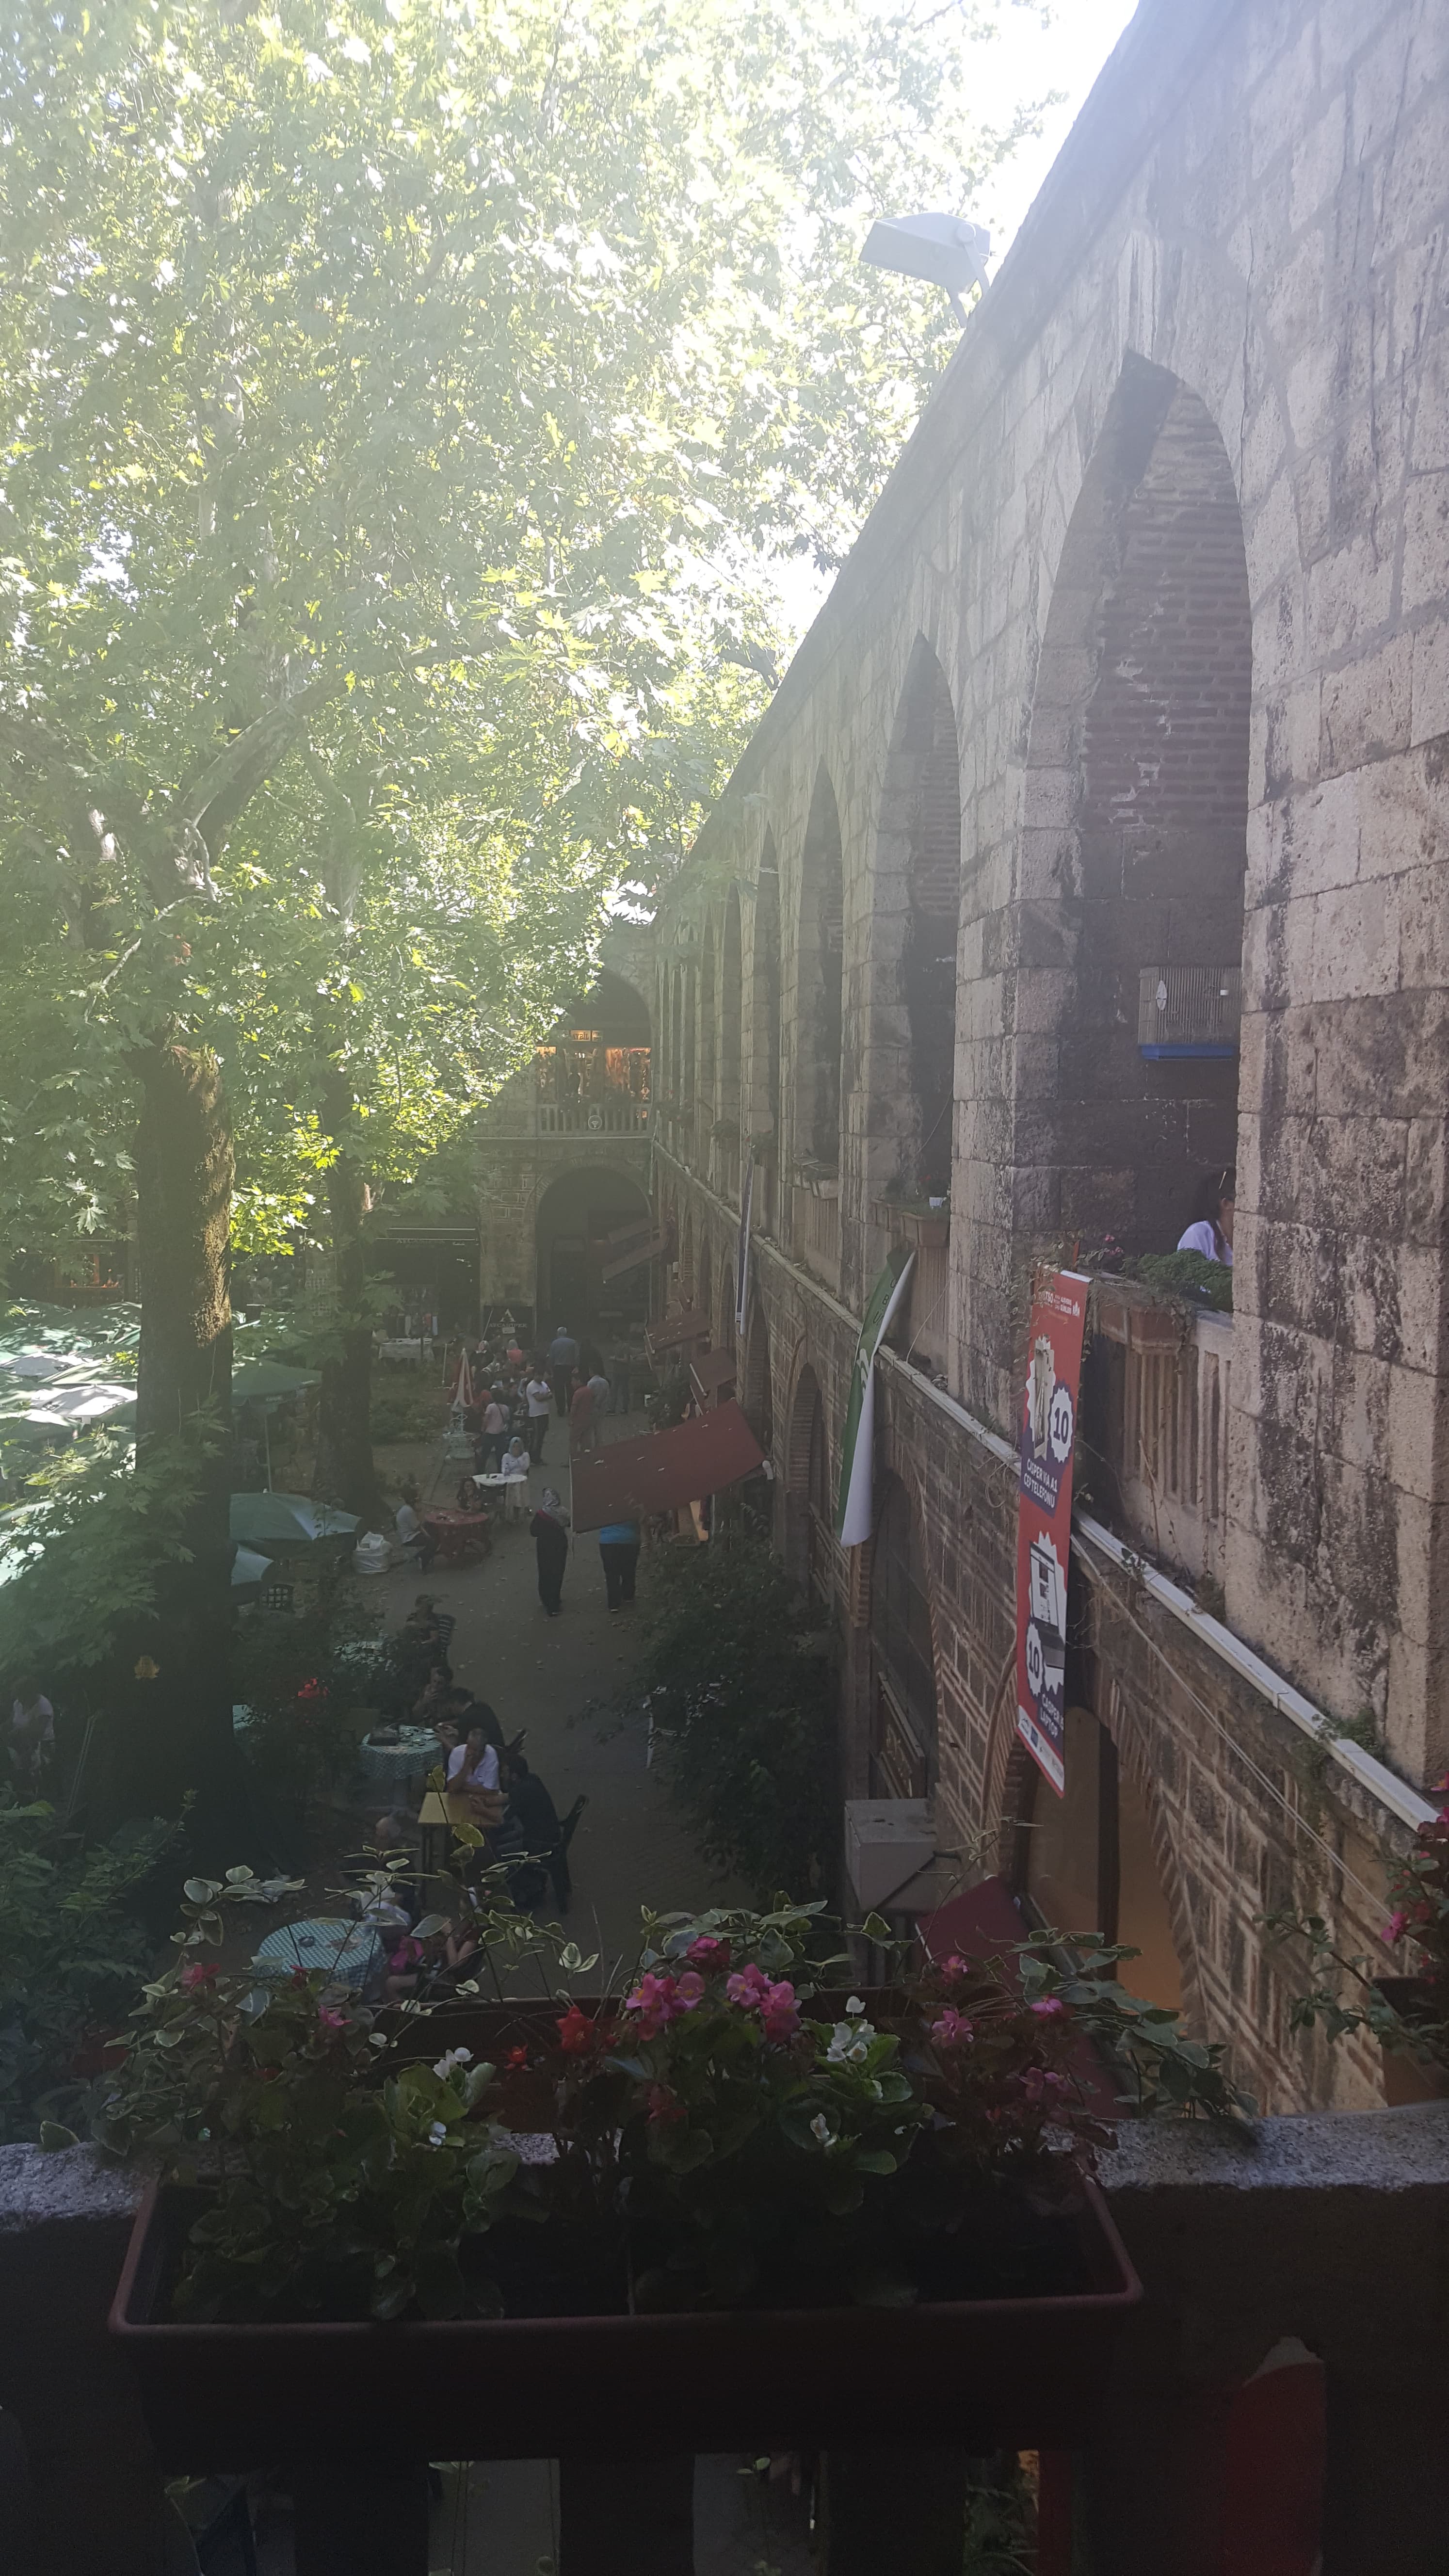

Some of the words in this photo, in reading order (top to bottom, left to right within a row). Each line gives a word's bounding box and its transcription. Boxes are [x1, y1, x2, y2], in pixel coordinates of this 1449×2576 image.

[1053, 1407, 1068, 1444] 10
[1027, 1459, 1043, 1481] CASPER
[1050, 1477, 1058, 1493] A1
[1031, 1480, 1055, 1508] TELEFONU
[1029, 1640, 1039, 1679] 10
